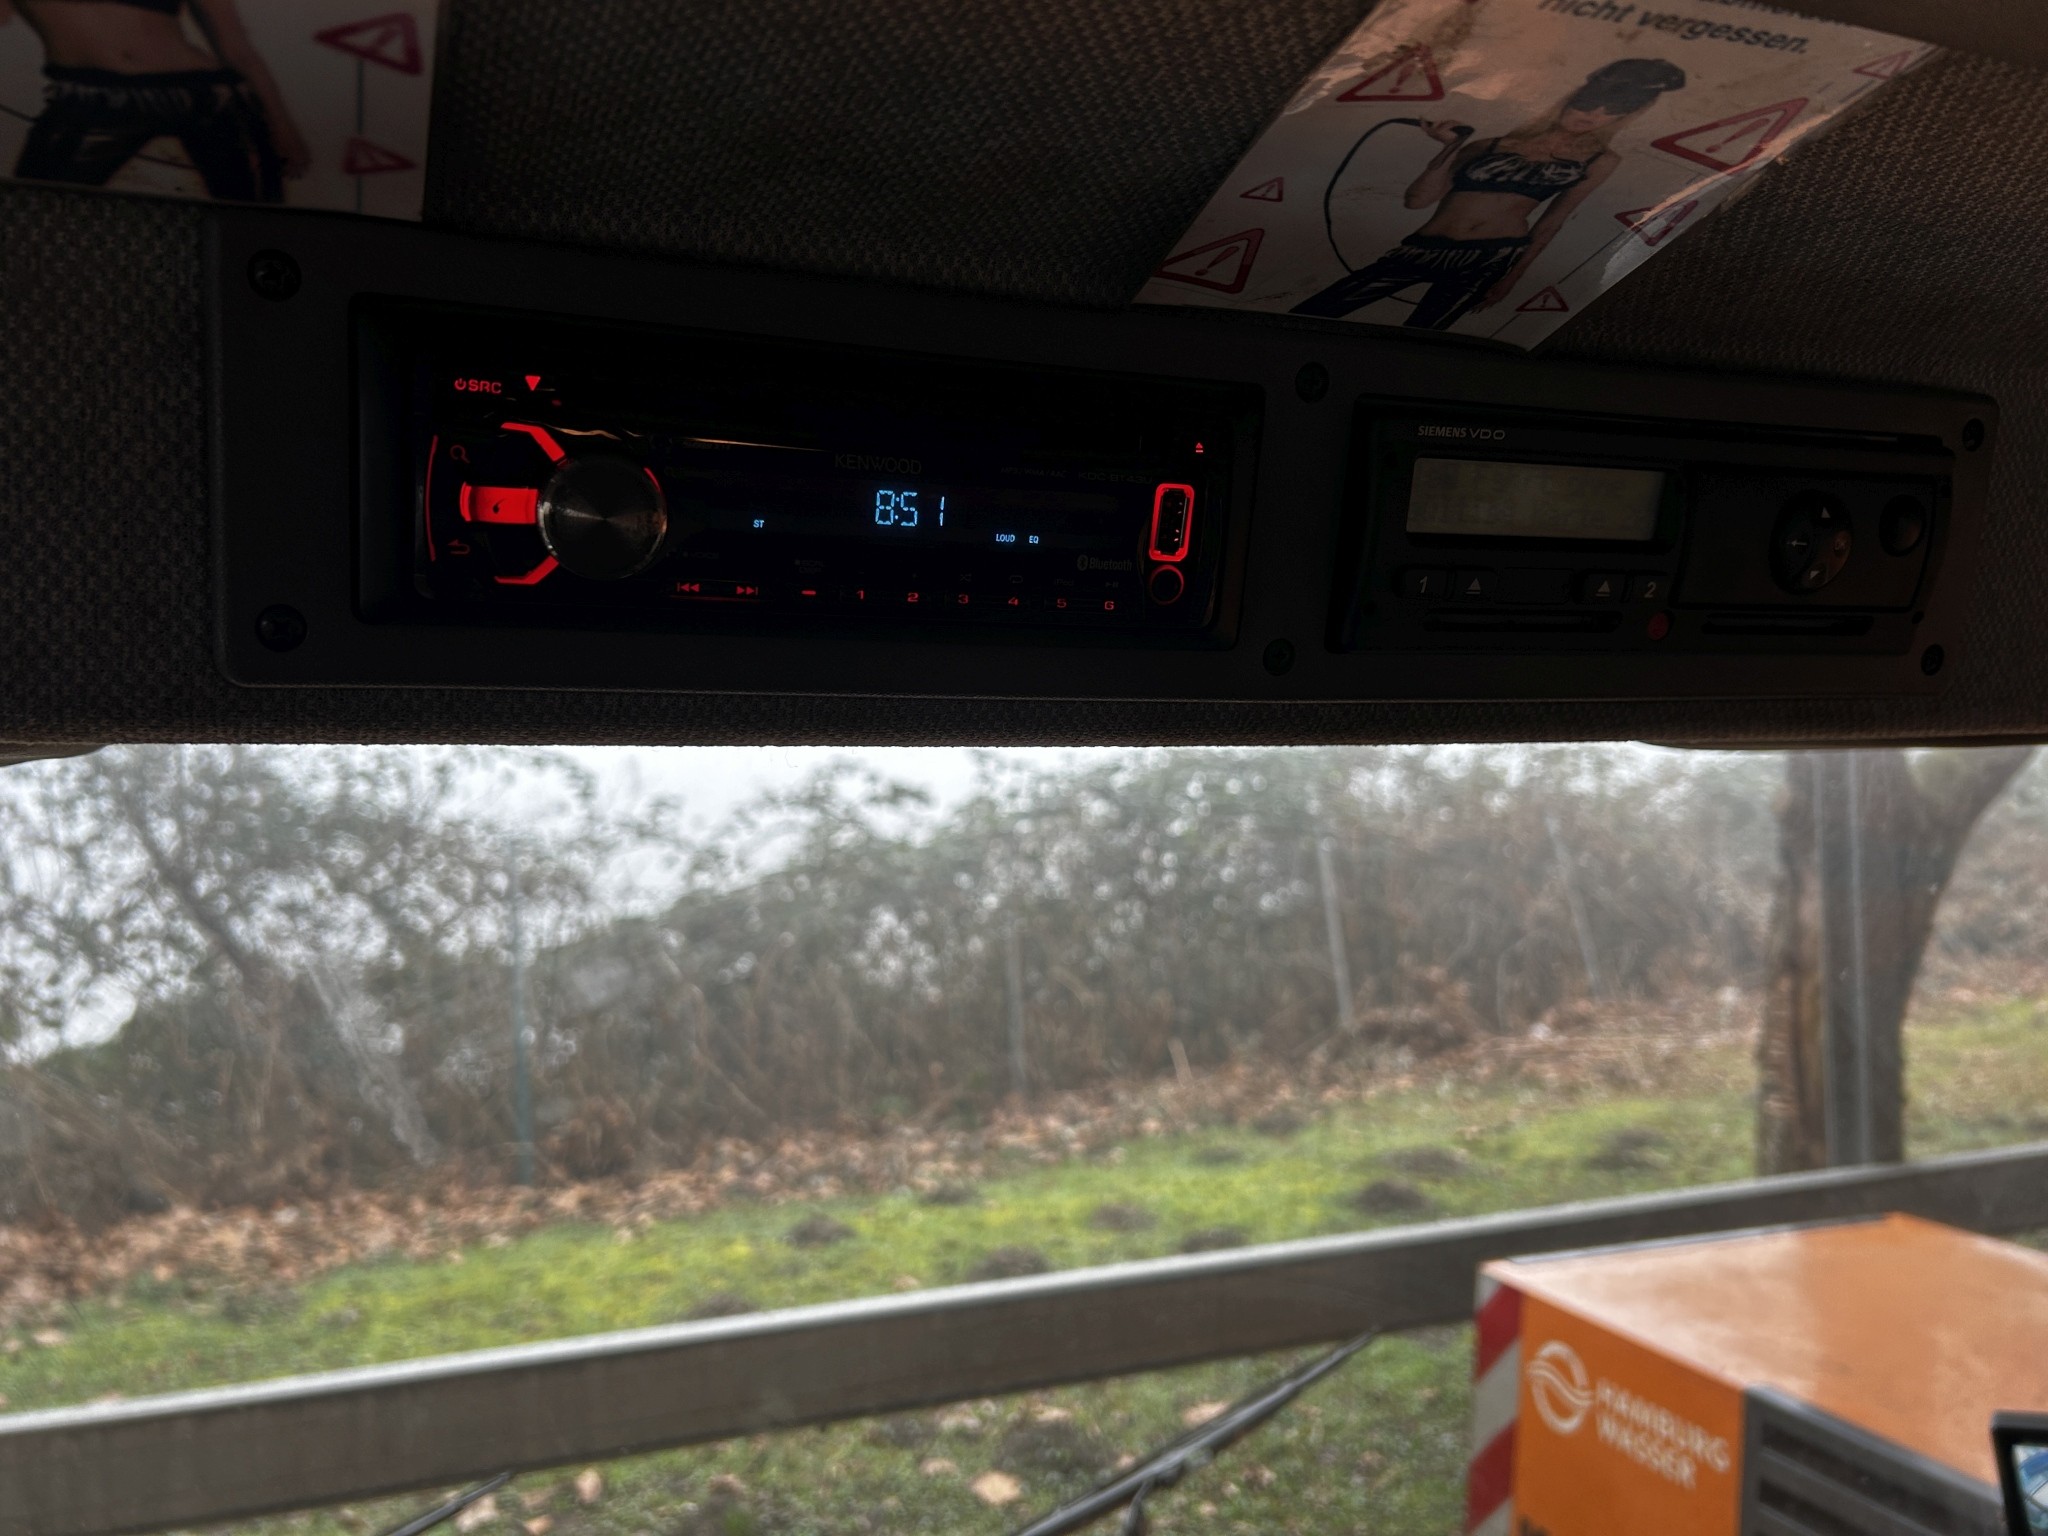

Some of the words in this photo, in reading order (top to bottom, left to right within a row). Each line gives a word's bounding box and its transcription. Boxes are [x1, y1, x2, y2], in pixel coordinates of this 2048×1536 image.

[1538, 0, 1624, 23] nicht
[1637, 10, 1808, 55] vergessen.
[468, 379, 504, 396] SRC
[1417, 424, 1467, 440] SIEMENS
[1469, 428, 1506, 442] VDO
[834, 454, 923, 476] KENWOOD
[874, 489, 946, 527] 8:51
[753, 518, 766, 530] ST
[995, 532, 1016, 544] LOUD
[1028, 534, 1040, 545] EQ
[1088, 556, 1133, 573] Bluetooth
[1418, 575, 1428, 593] 1
[1643, 581, 1656, 599] 2
[856, 588, 867, 602] 1
[906, 591, 920, 604] 2
[956, 593, 970, 606] 3
[1007, 595, 1021, 608] 4
[1056, 598, 1068, 609] 5
[1104, 600, 1116, 611] 6
[1596, 1376, 1730, 1474] HAMBURG
[1596, 1413, 1698, 1488] WASSER
